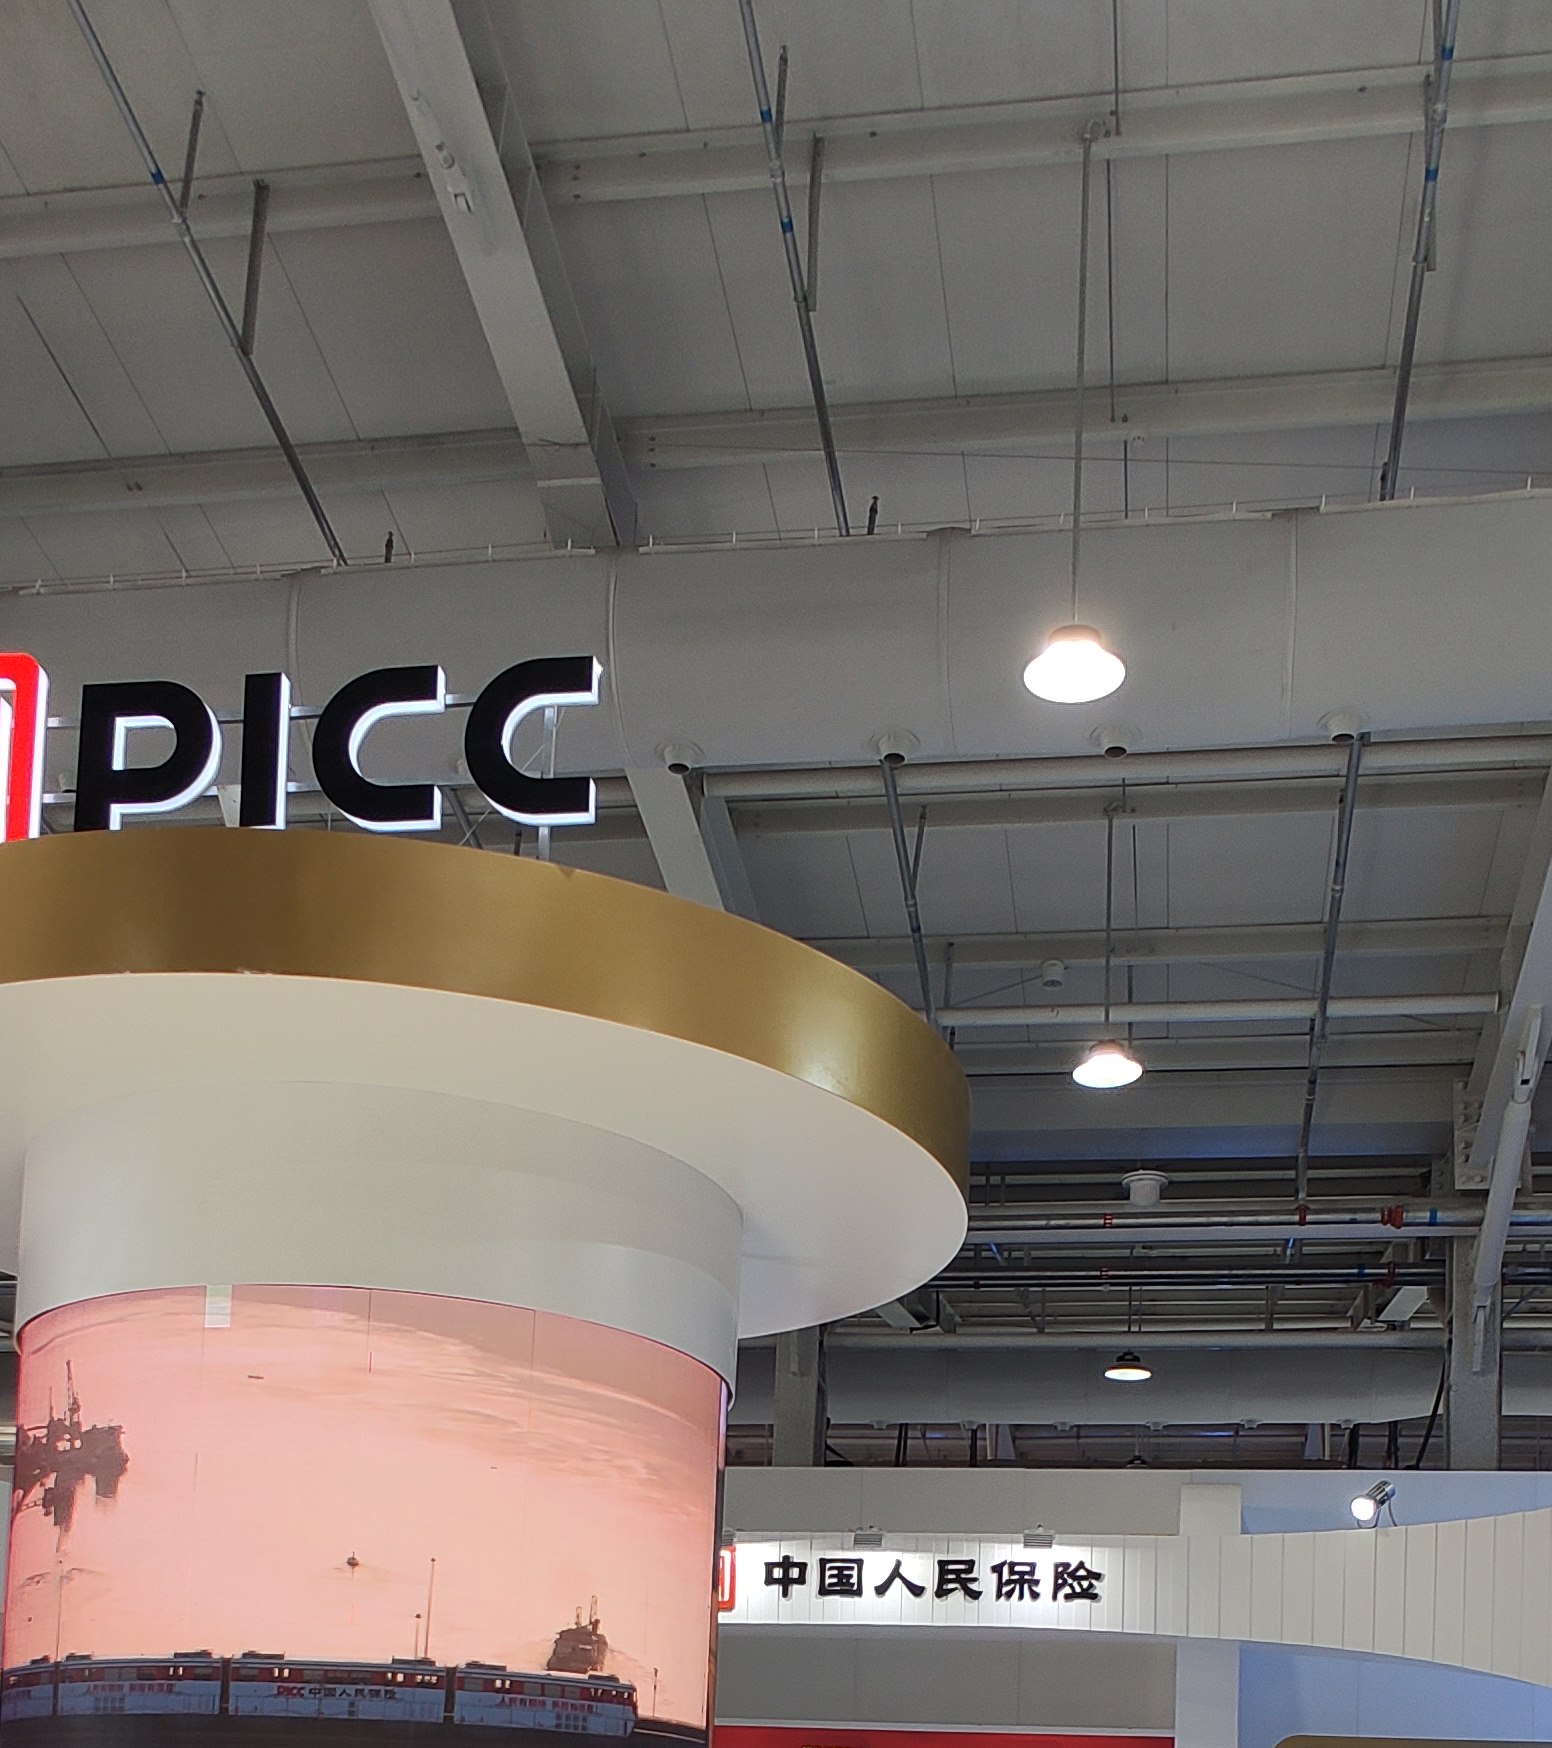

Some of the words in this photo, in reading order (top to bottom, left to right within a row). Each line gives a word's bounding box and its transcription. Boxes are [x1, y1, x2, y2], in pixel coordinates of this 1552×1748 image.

[73, 656, 598, 830] PICC
[763, 1553, 1104, 1602] 中国人民保险
